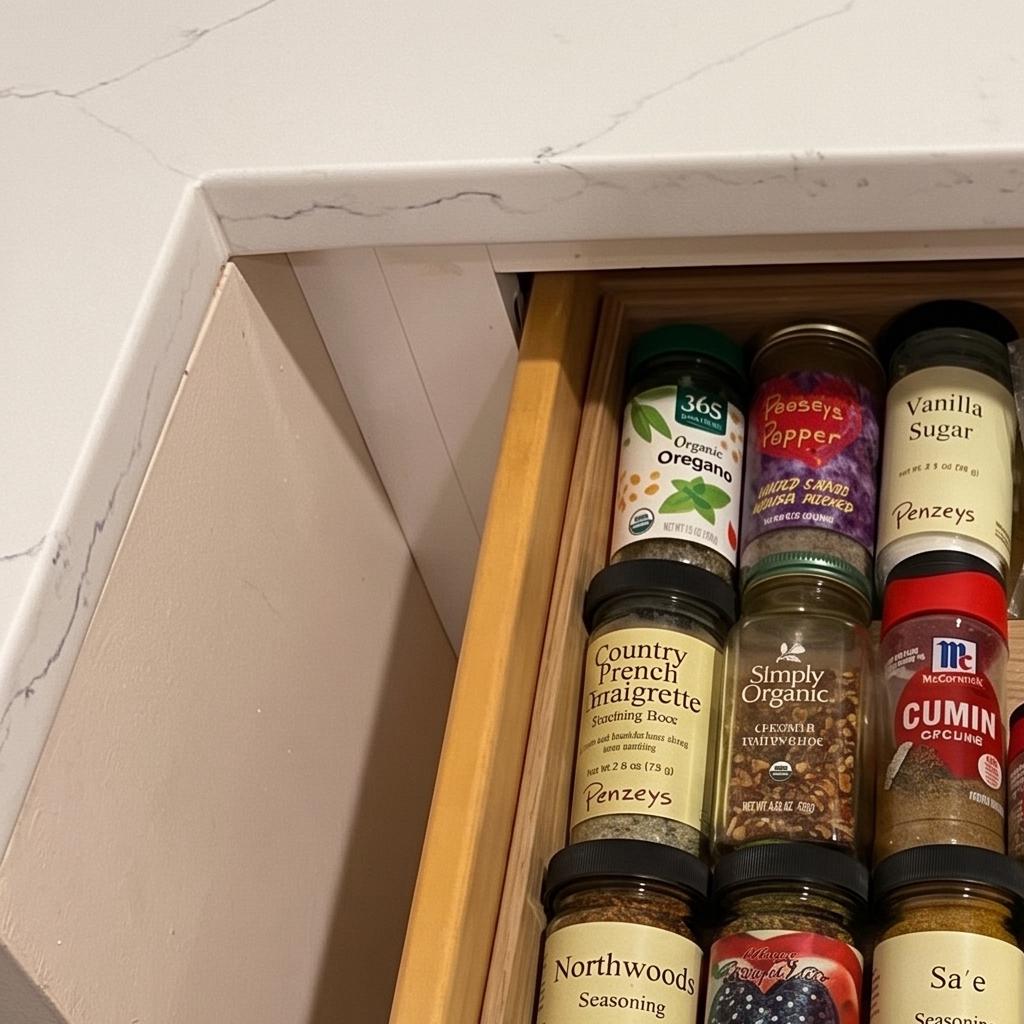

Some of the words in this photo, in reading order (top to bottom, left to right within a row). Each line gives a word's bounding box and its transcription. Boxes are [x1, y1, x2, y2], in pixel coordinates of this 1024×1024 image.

[907, 394, 983, 418] Vanilla
[909, 422, 973, 441] Sugar
[674, 436, 723, 459] Organic
[658, 451, 732, 483] Oregano
[892, 502, 975, 529] Penzeys
[595, 643, 687, 668] Country
[742, 684, 828, 708] Organic
[903, 699, 996, 740] CUMIN
[583, 782, 672, 811] Penzeys
[553, 952, 695, 996] Northwoods
[578, 992, 666, 1018] Seasoning
